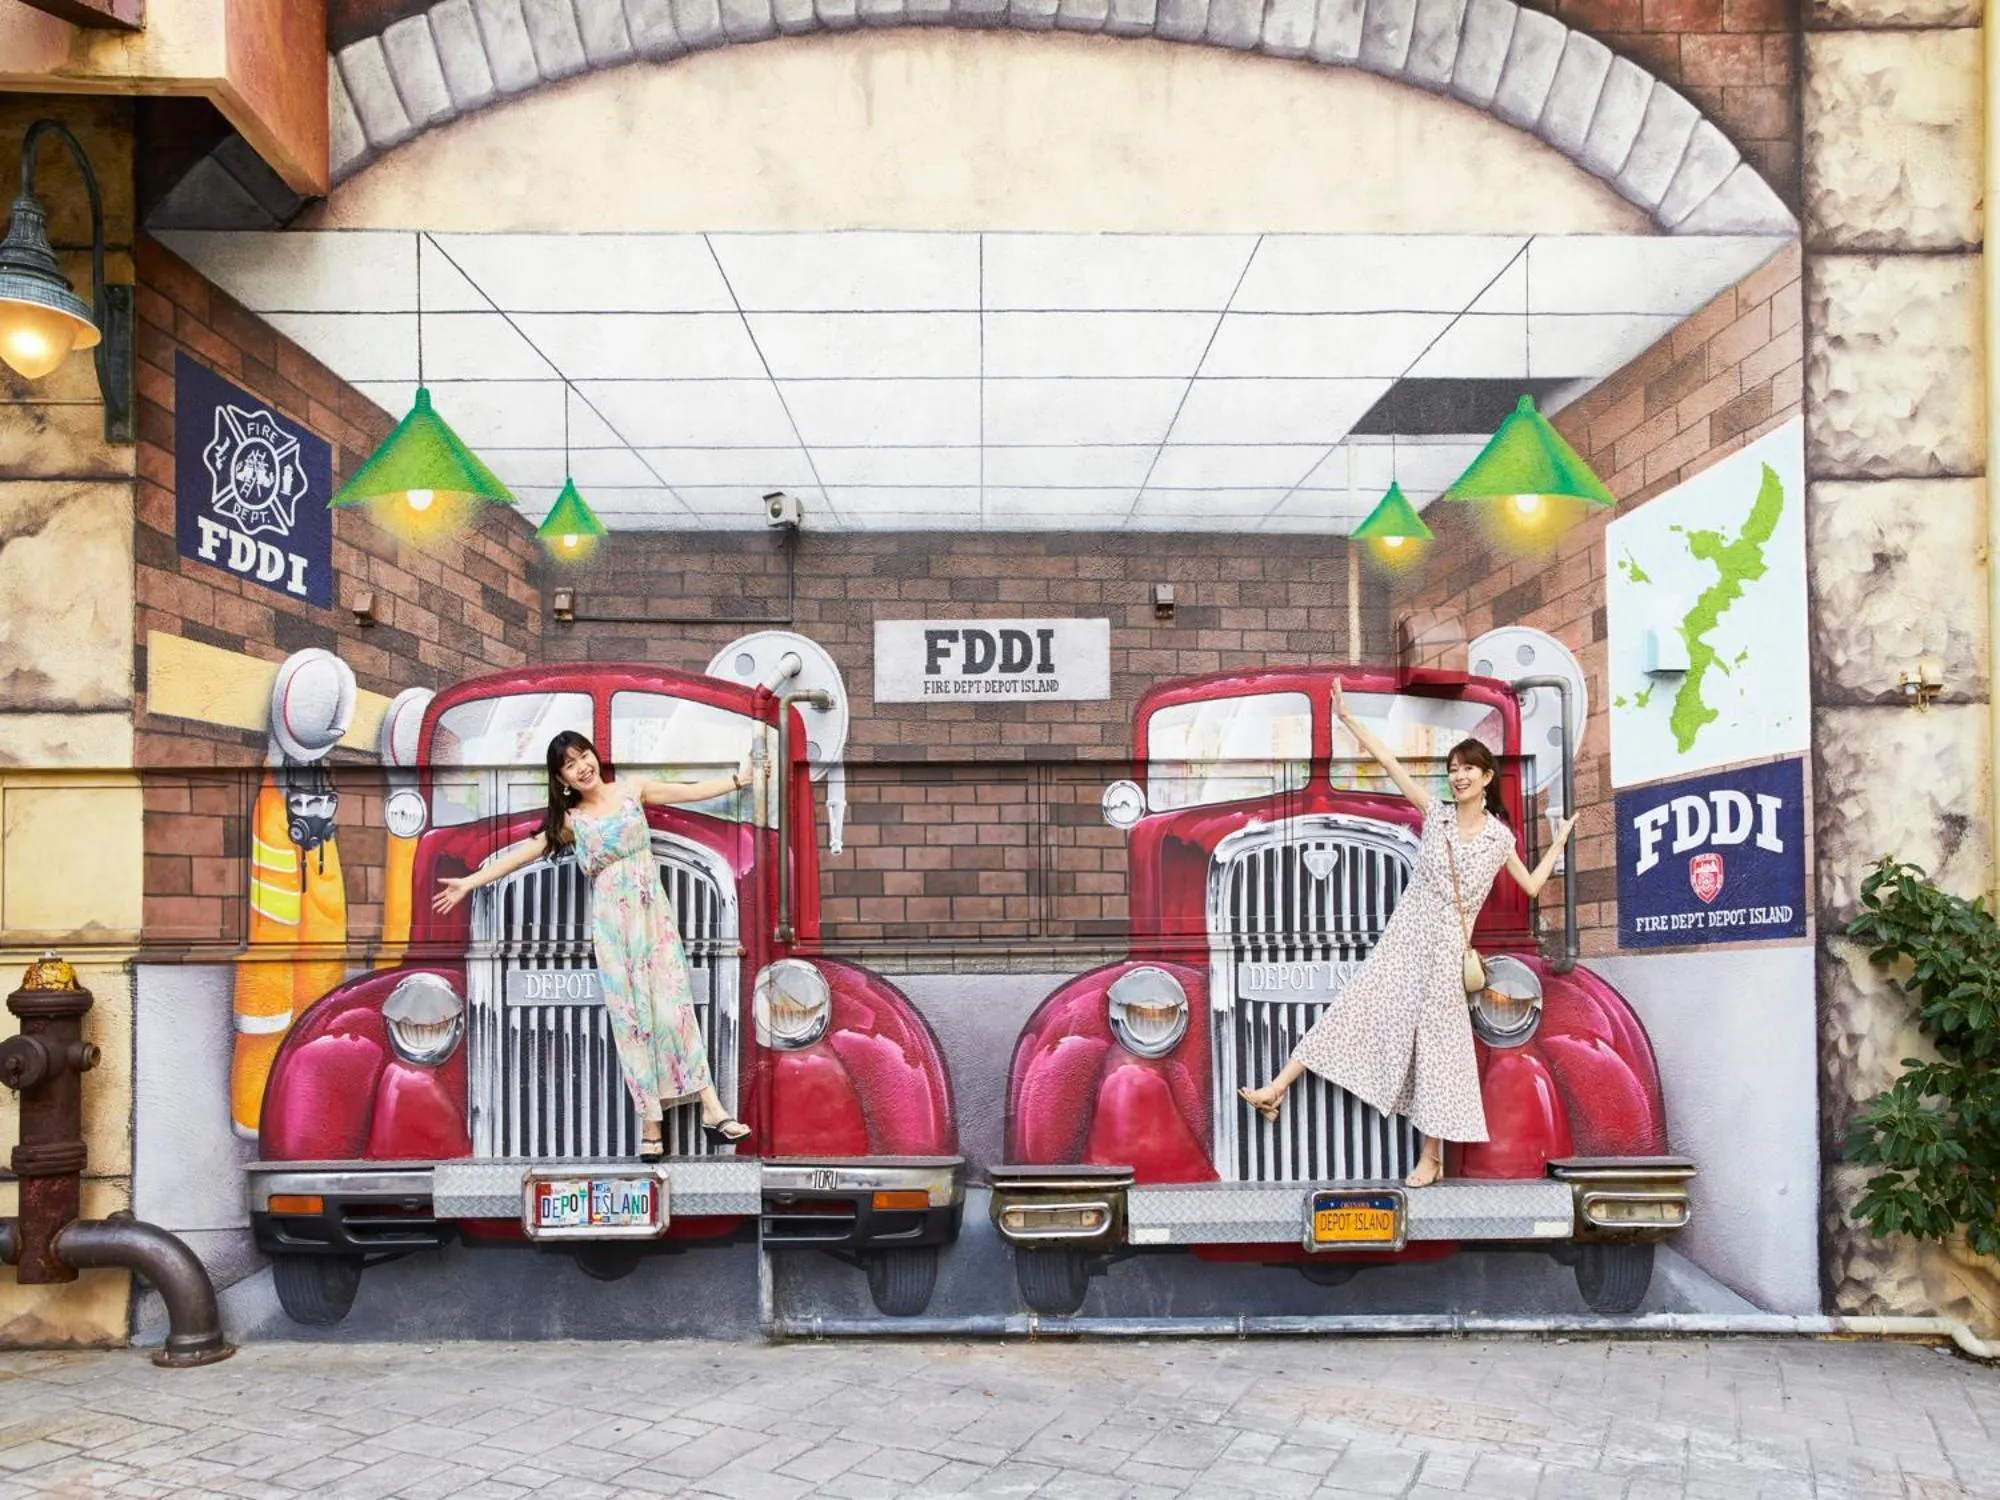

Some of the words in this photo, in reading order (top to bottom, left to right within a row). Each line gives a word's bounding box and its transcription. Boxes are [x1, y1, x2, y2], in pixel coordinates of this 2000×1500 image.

[247, 422, 278, 443] FIRE
[233, 503, 271, 524] DEPT.
[197, 515, 308, 596] FDDI
[924, 629, 1055, 675] FDDI
[923, 680, 951, 694] FIRE
[954, 680, 982, 694] DEPT
[984, 679, 1019, 694] DEPOT
[1021, 679, 1060, 693] ISLAND
[1633, 789, 1784, 877] FDDI
[1635, 915, 1668, 932] FIRE
[1671, 912, 1705, 930] DEPT
[1707, 908, 1747, 926] DEPOT
[1748, 905, 1793, 924] ISLAND
[524, 972, 598, 999] DEPOT
[1248, 963, 1320, 991] DEPOT
[542, 1187, 588, 1219] DEPOT
[593, 1193, 649, 1215] ISLAND
[1320, 1212, 1352, 1232] DEPOT
[1354, 1211, 1390, 1231] ISLAND
